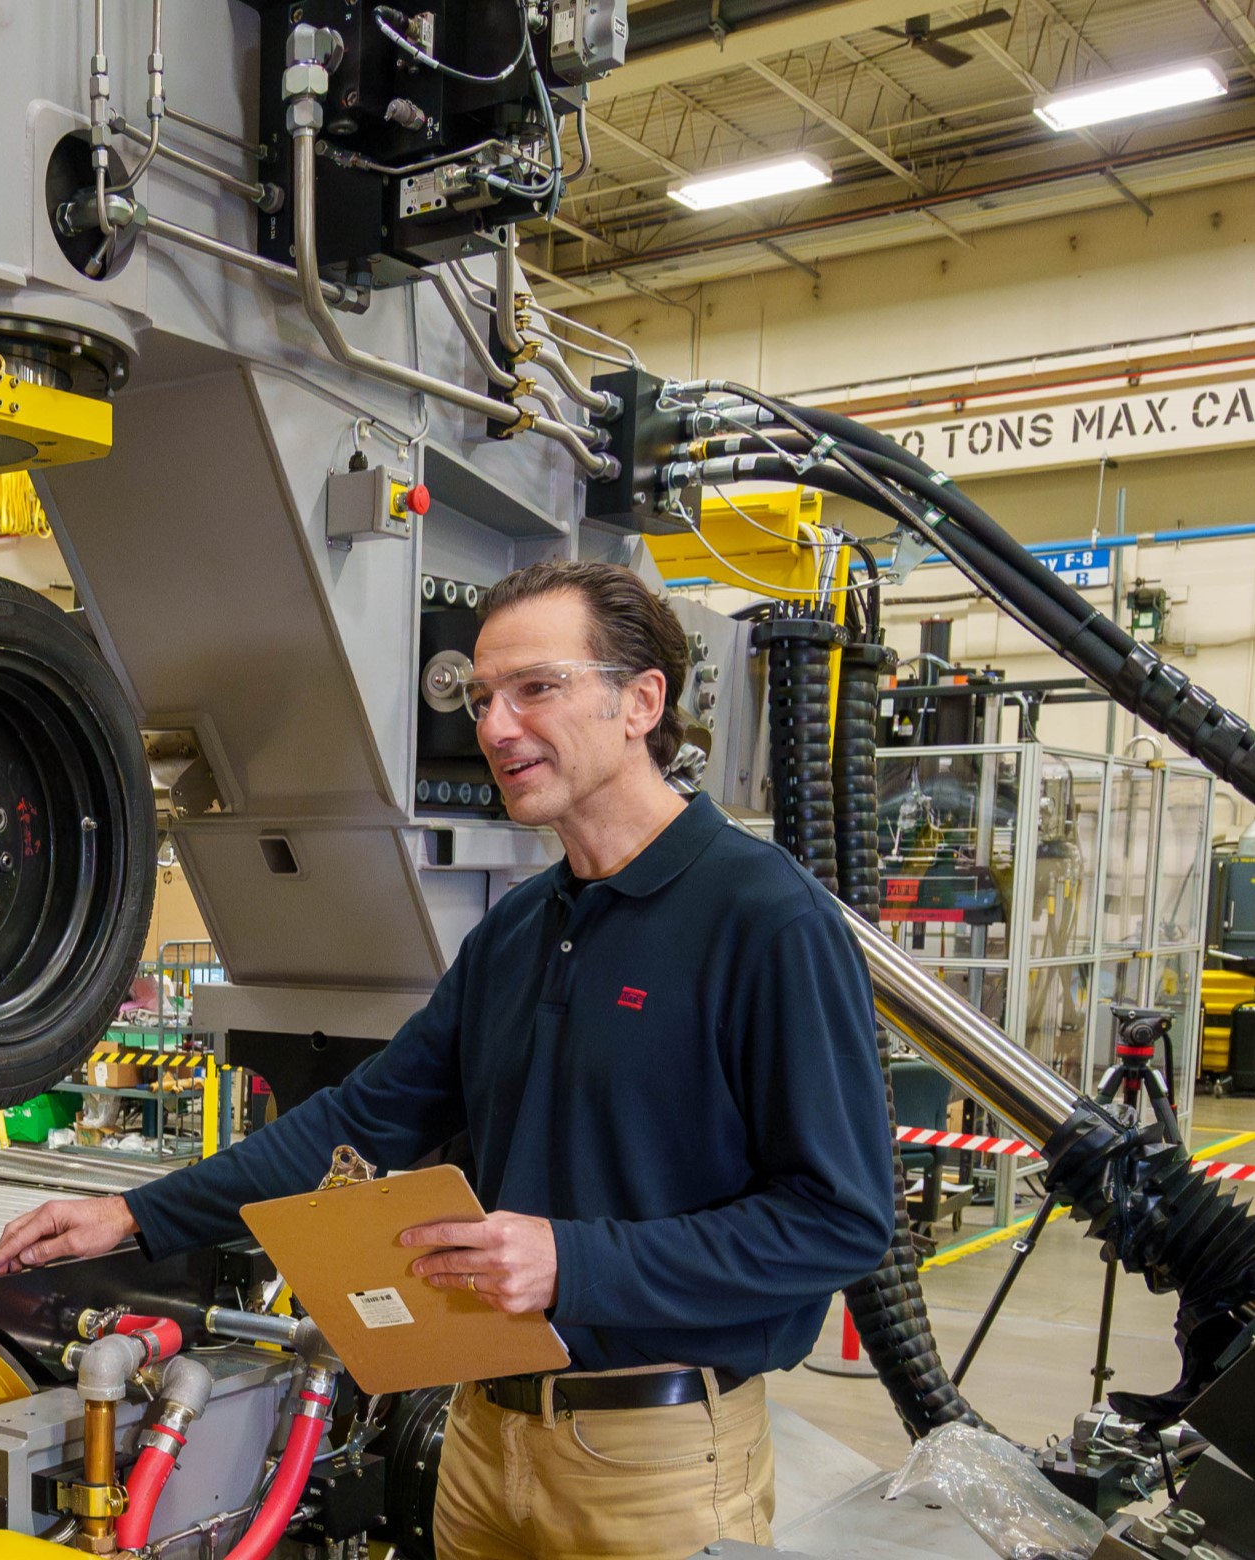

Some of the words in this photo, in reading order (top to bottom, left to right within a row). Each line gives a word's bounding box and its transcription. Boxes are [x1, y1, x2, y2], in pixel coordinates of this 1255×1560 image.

[884, 429, 925, 460] 0
[941, 413, 1054, 459] TONS
[1072, 397, 1177, 443] MAX.
[1064, 551, 1093, 568] F-8
